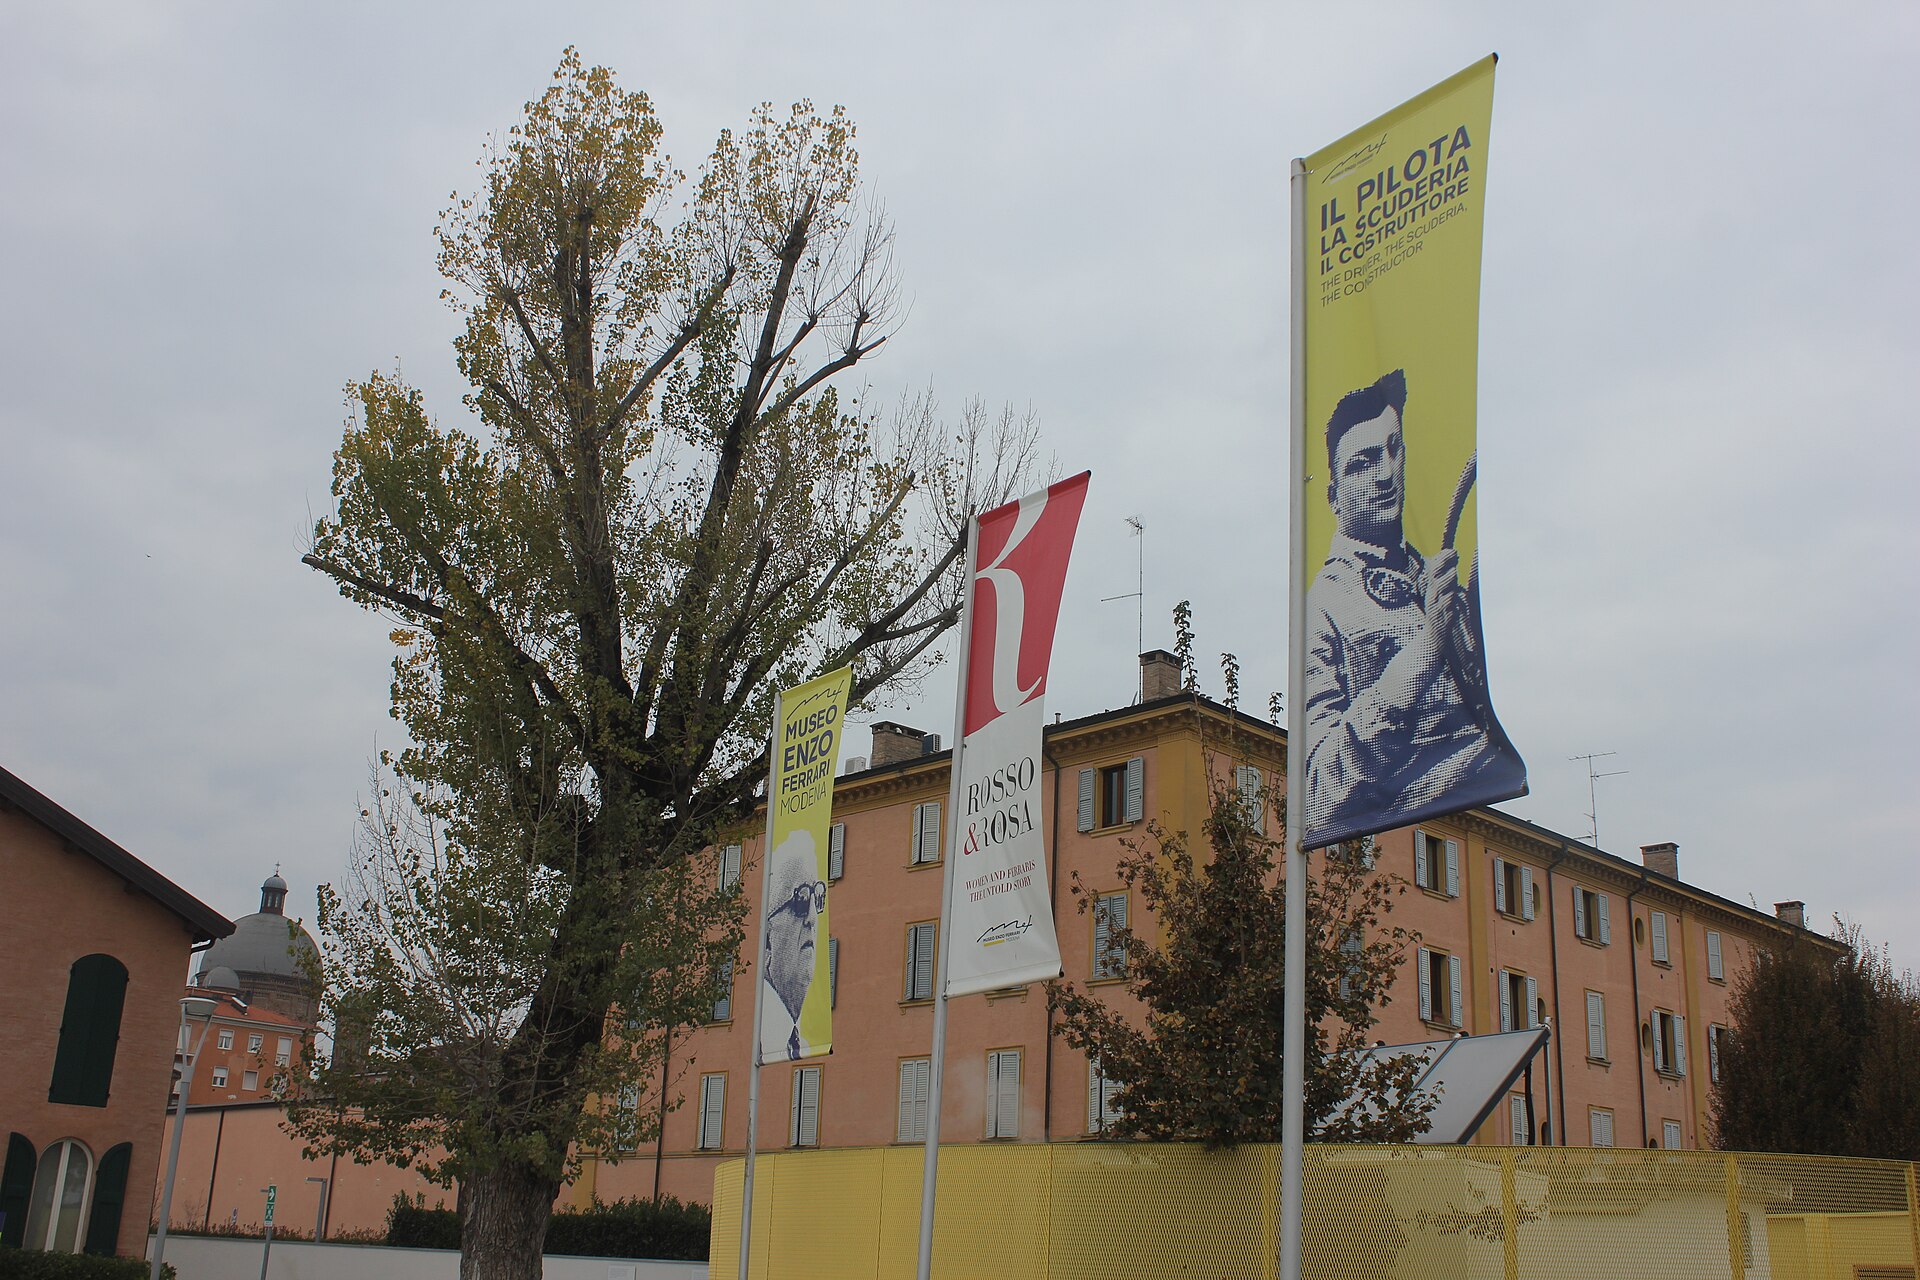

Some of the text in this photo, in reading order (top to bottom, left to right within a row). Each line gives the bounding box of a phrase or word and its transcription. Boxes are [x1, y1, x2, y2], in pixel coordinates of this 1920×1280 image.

[1321, 197, 1346, 232] IL
[1356, 125, 1472, 214] PILOTA
[1320, 226, 1347, 256] LA
[1355, 155, 1470, 239] SCUDERIA
[1320, 177, 1469, 276] IL COSTRUTTORE
[1320, 273, 1341, 293] THE
[1385, 236, 1404, 257] THE
[1407, 202, 1468, 244] SCUDERIA,
[1320, 241, 1424, 308] THE CONSTRUCTOR
[785, 704, 838, 742] MUSEO
[781, 758, 831, 795] FERRARI
[783, 729, 834, 773] ENZO
[780, 781, 827, 817] MODENA
[966, 756, 1035, 817] ROSSO
[965, 859, 1036, 890] WOMEN AND FERRARIS
[970, 875, 1032, 903] THE UNTOLD STORY
